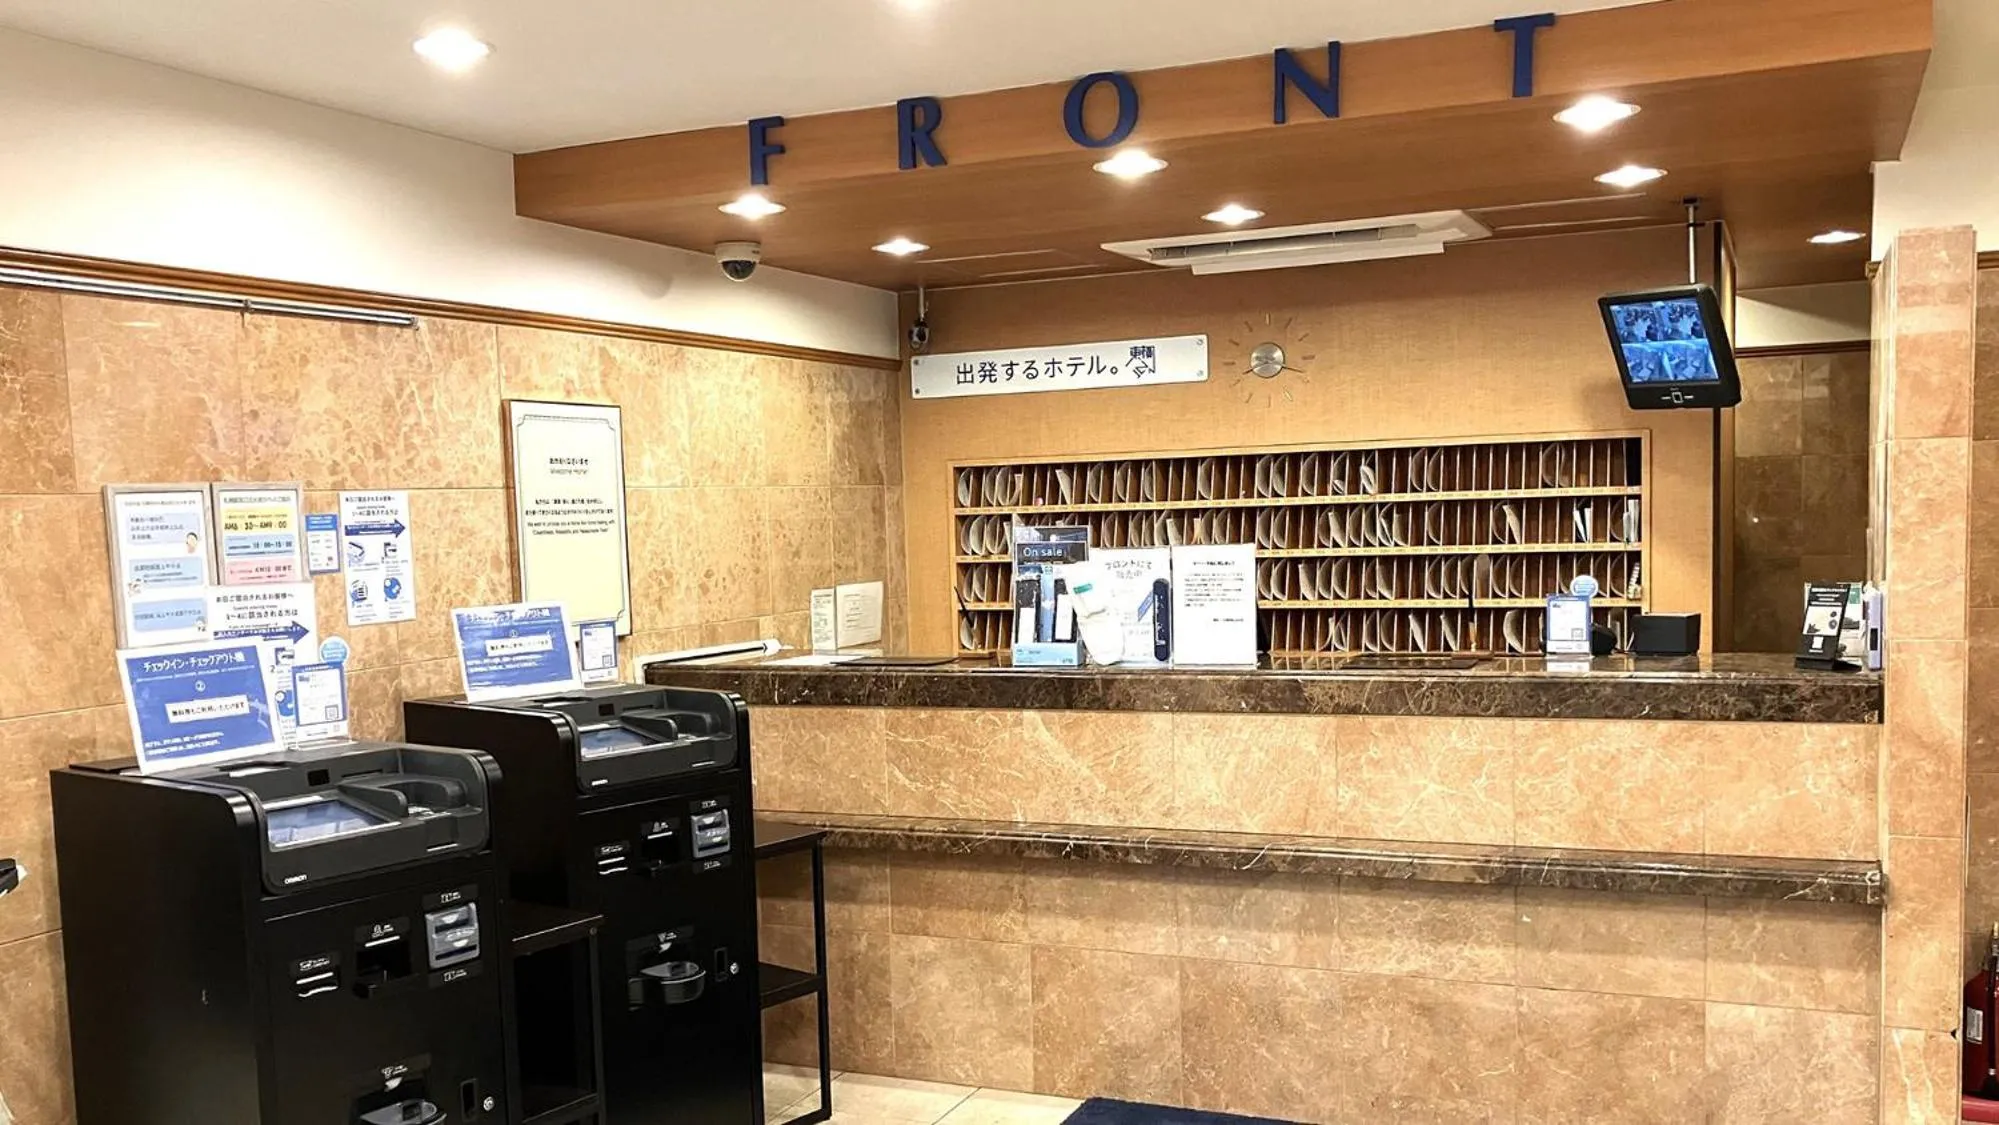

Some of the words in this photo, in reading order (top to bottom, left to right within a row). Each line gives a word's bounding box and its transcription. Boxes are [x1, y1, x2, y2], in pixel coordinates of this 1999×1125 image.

[748, 13, 1556, 185] FRONT
[956, 355, 1119, 384] 出発するホテル。
[1023, 548, 1038, 557] On
[1041, 547, 1063, 556] sale
